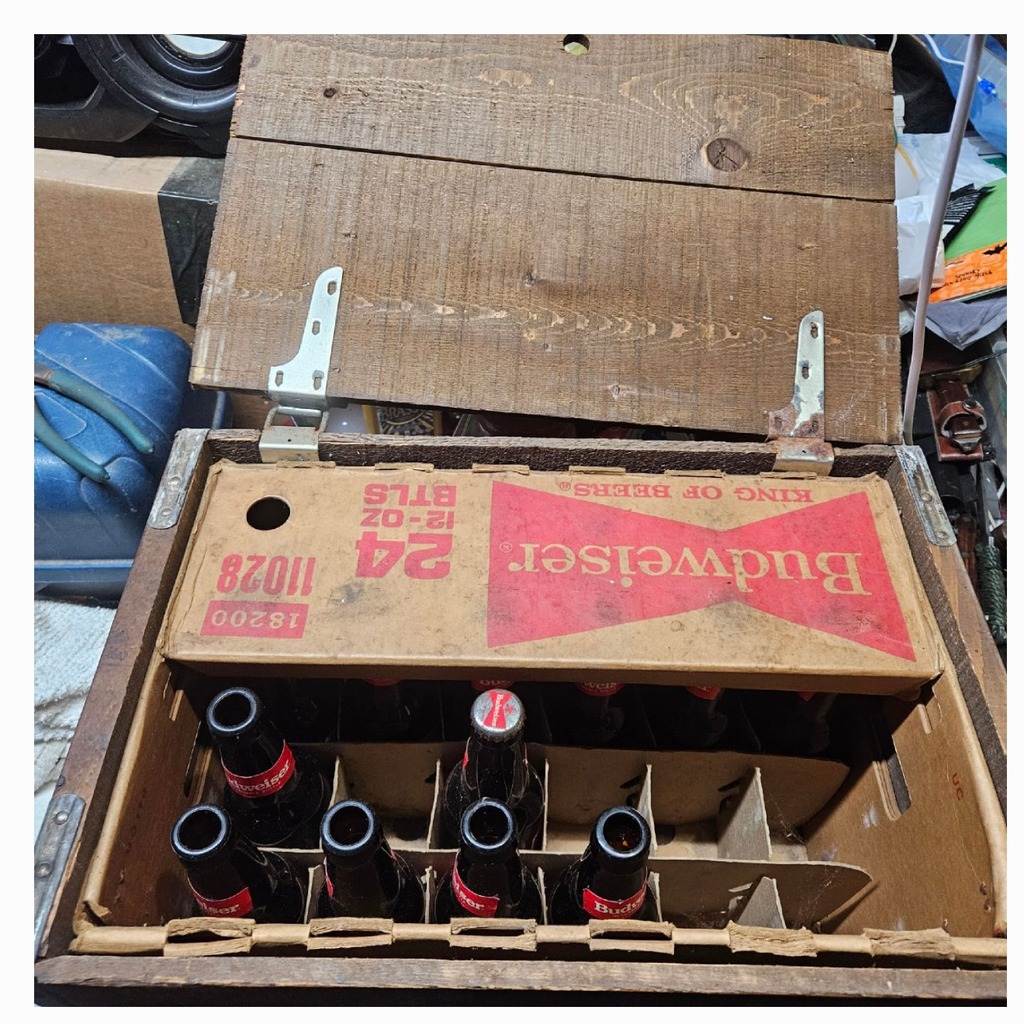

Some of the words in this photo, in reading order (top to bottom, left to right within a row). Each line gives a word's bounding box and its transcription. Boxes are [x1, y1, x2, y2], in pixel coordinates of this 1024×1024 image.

[363, 483, 457, 507] BTLS
[683, 486, 722, 500] OF
[733, 488, 813, 502] KING
[355, 531, 454, 579] 24
[216, 554, 316, 596] 11028
[211, 609, 301, 629] 18200
